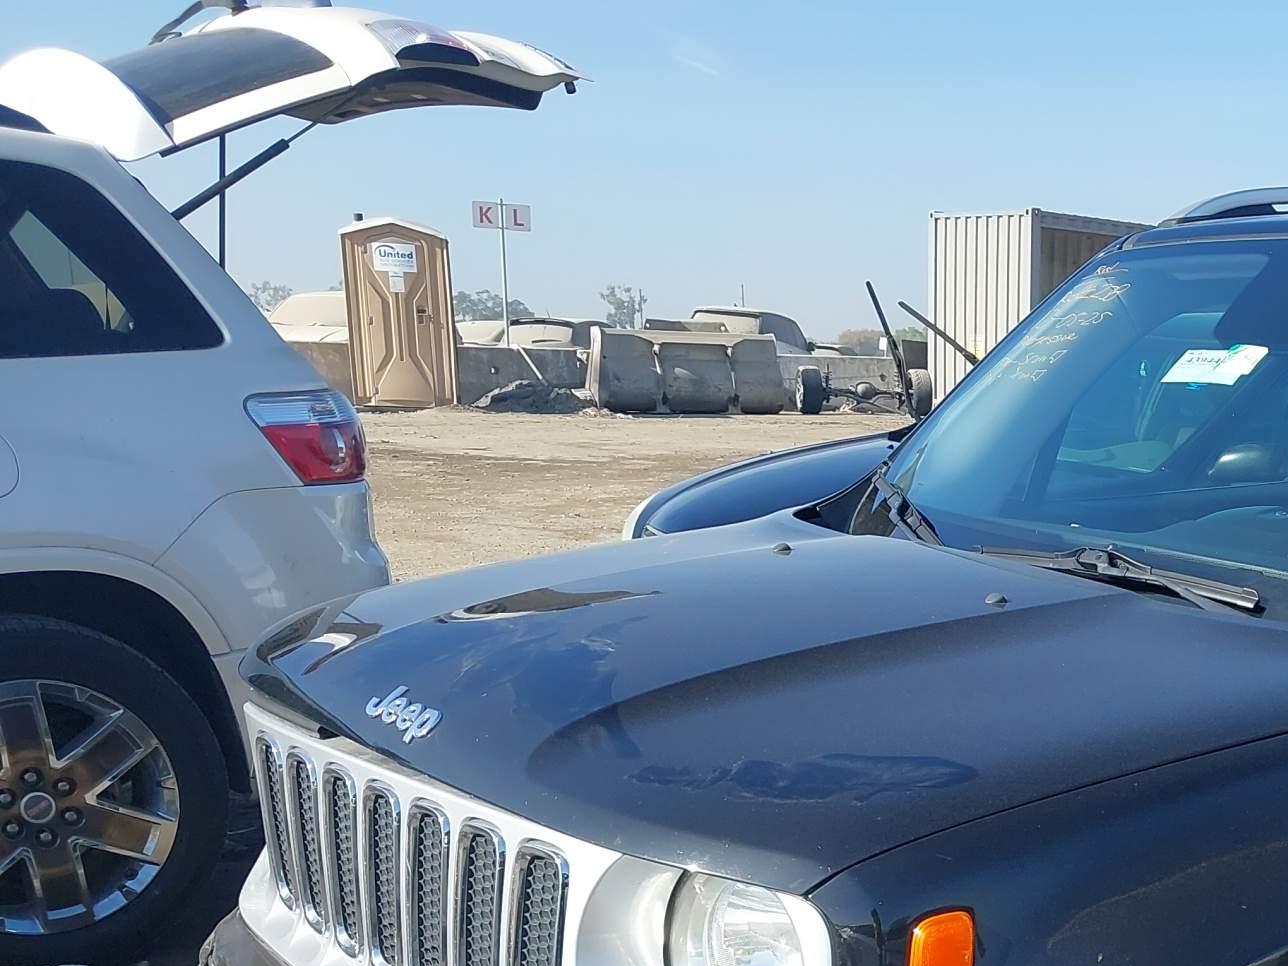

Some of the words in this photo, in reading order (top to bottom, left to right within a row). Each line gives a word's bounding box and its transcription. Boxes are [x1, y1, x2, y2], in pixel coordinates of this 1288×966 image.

[479, 205, 494, 225] K
[512, 208, 525, 227] L
[378, 248, 414, 260] United
[365, 685, 442, 744] Jeep
